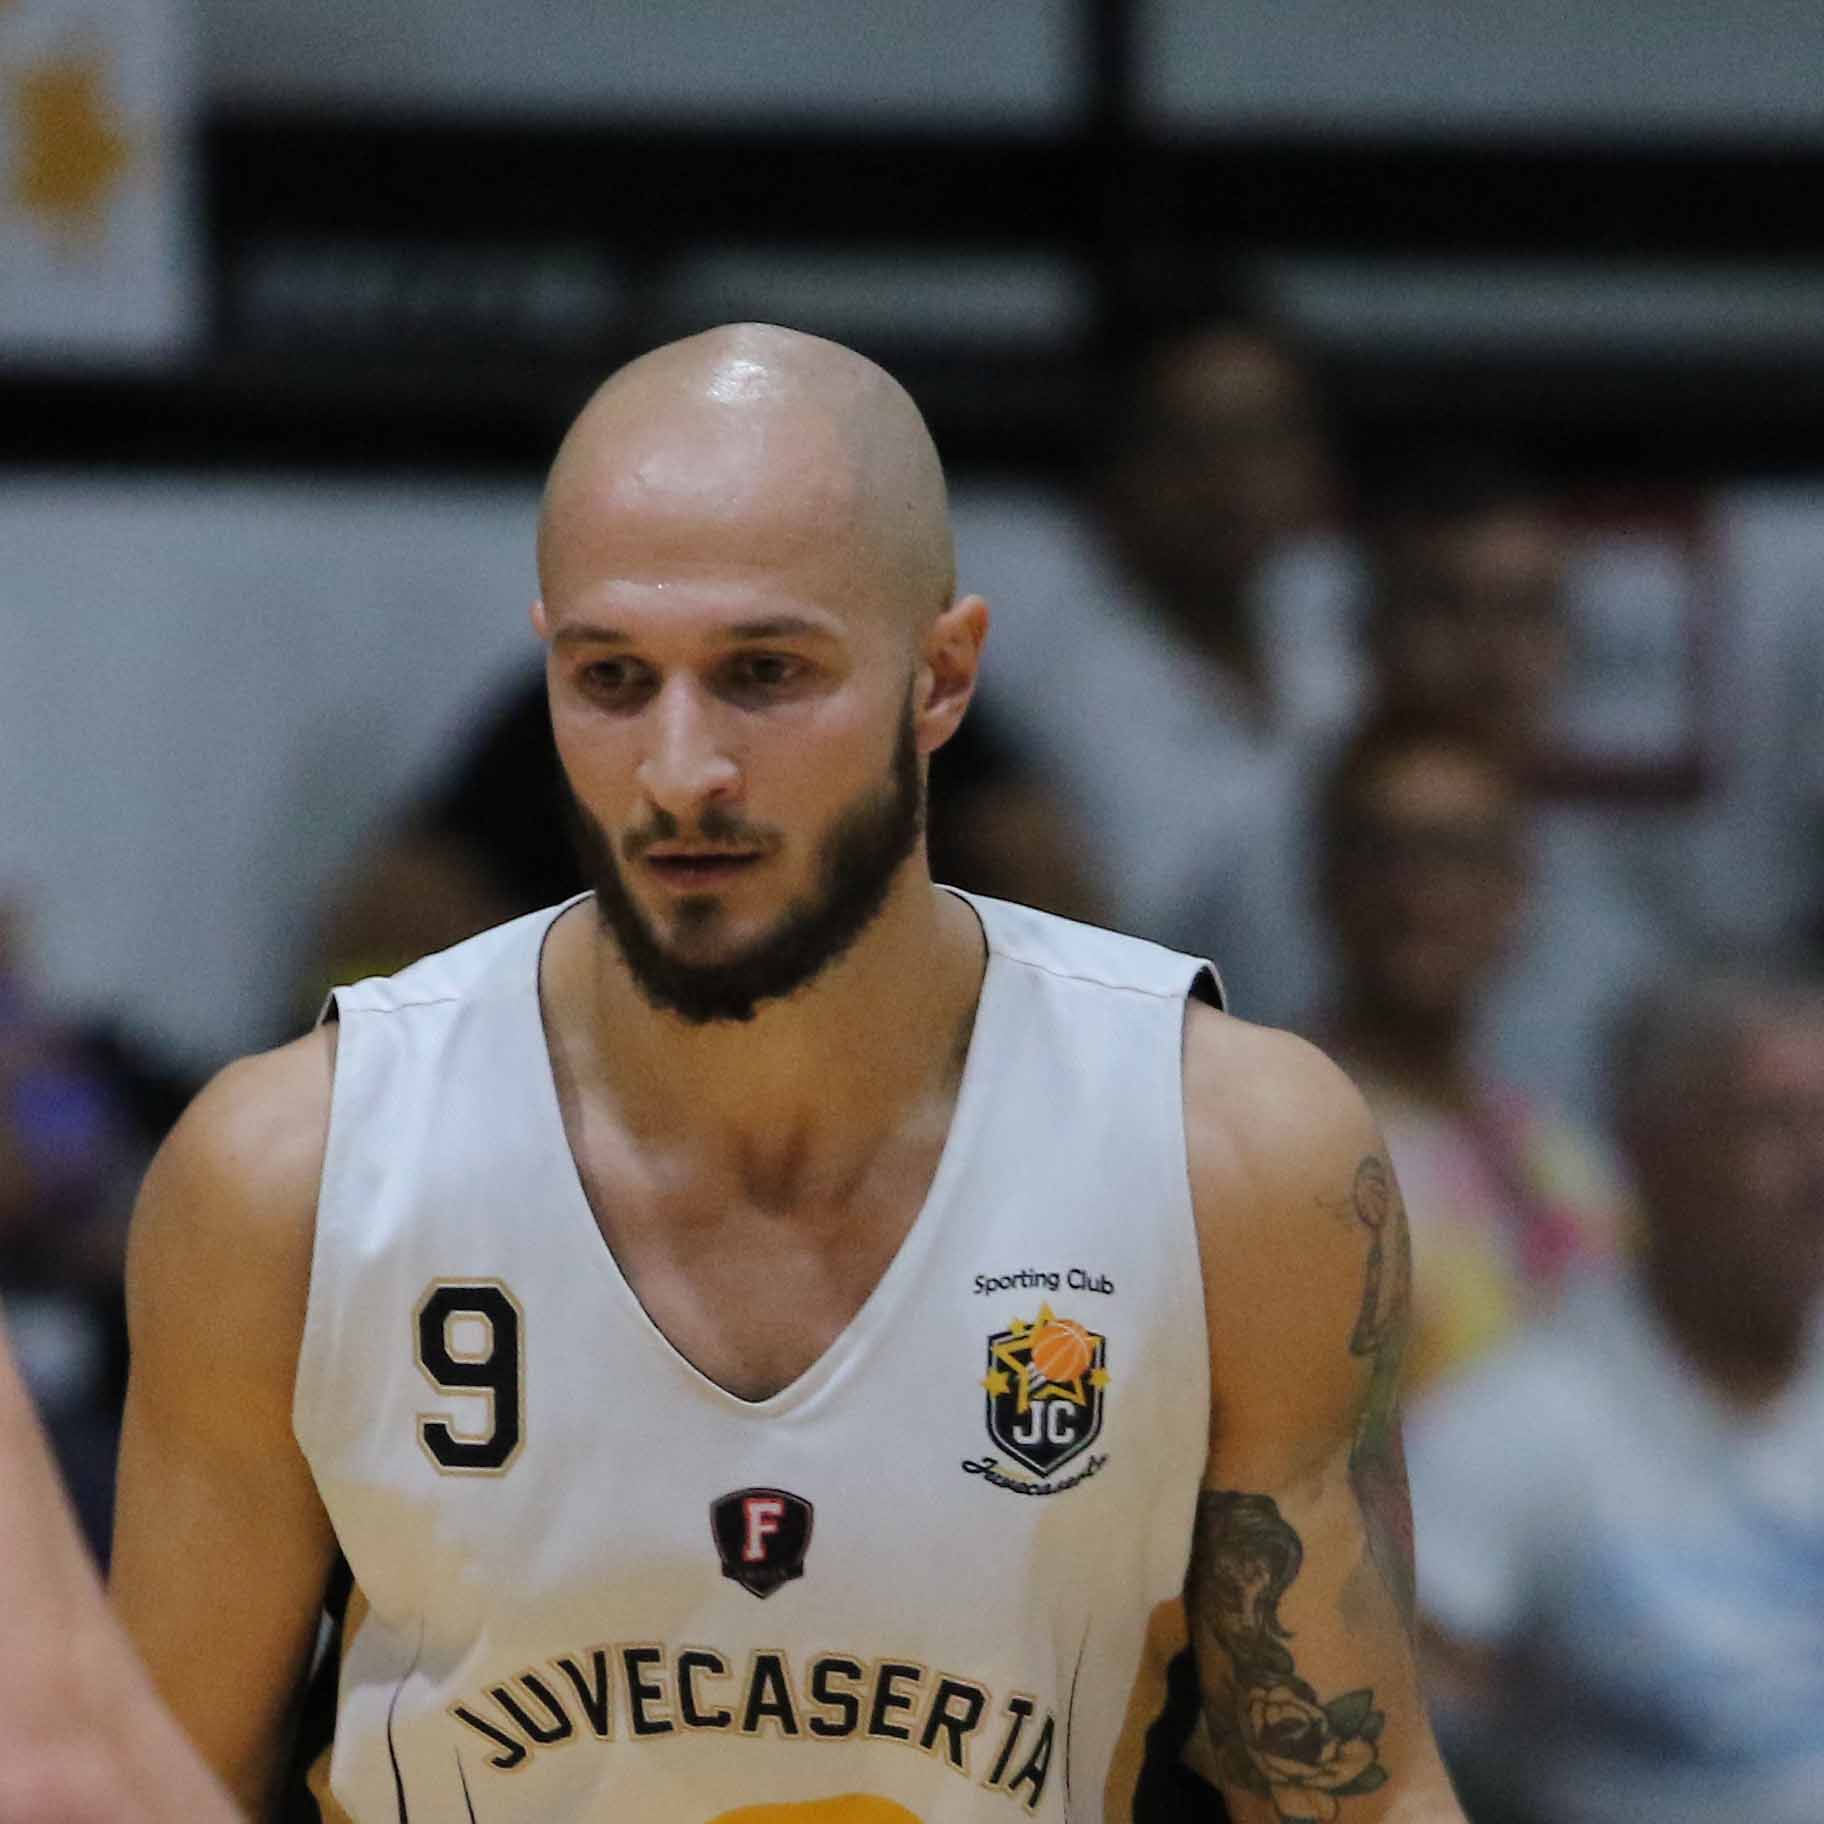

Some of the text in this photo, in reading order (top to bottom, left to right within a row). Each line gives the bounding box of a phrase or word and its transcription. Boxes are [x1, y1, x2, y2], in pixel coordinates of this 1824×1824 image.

[974, 1268, 1115, 1297] Sporting Club
[414, 1278, 525, 1475] 9
[1012, 1399, 1076, 1445] JC
[741, 1497, 785, 1563] F
[448, 1642, 1058, 1814] JUVECASERTA
